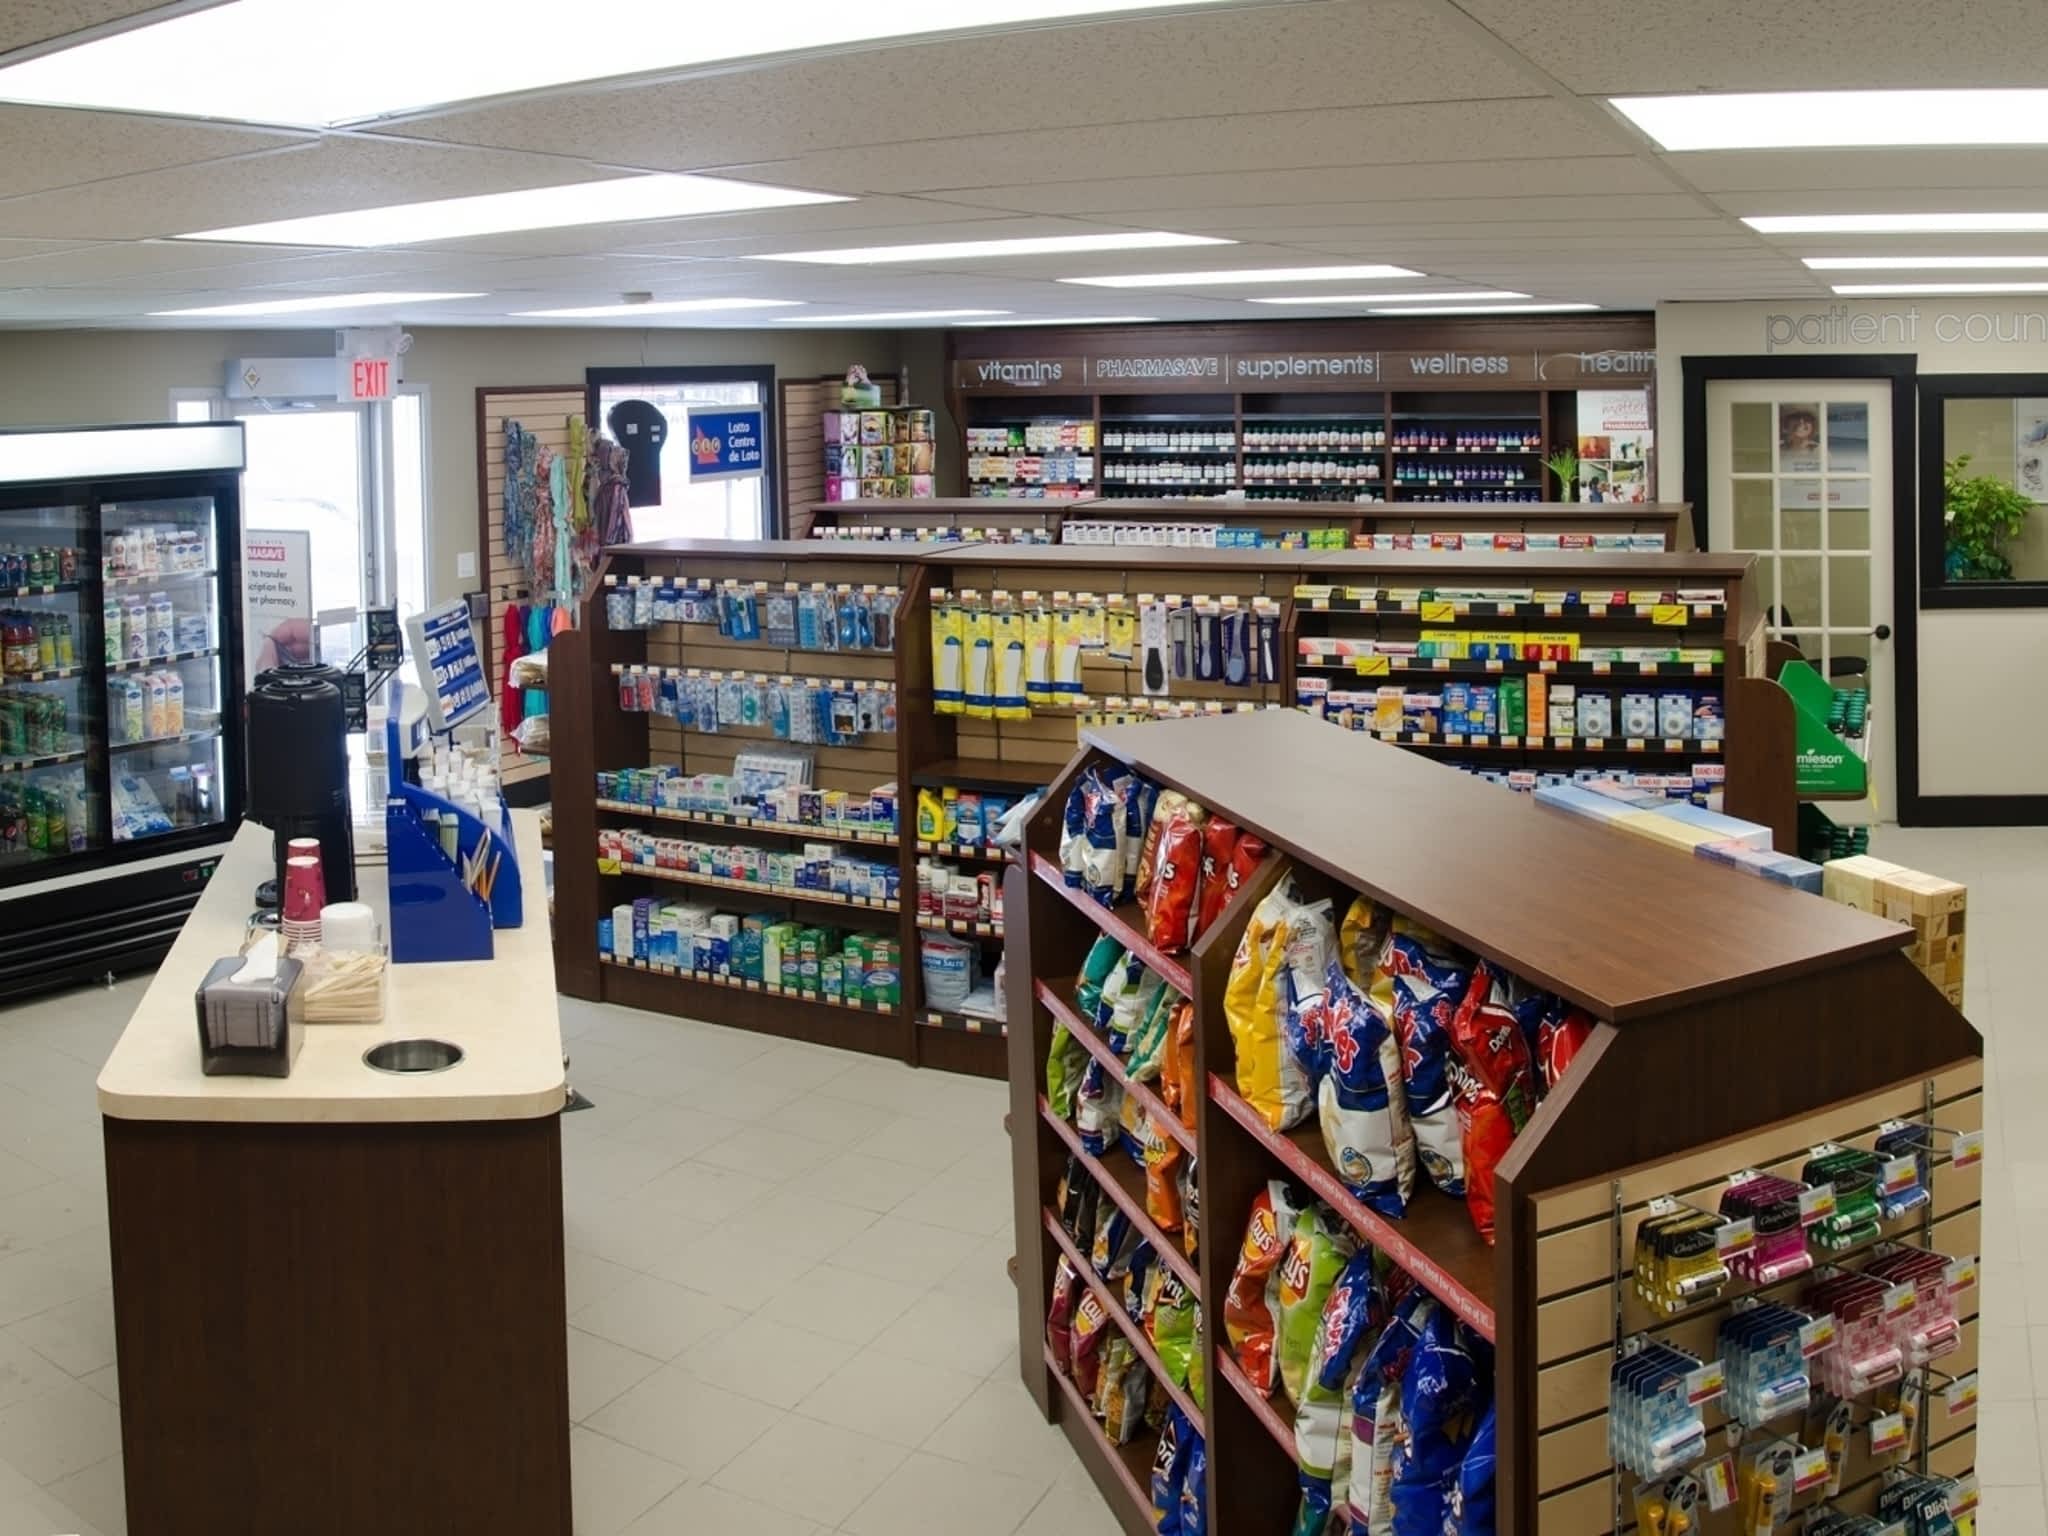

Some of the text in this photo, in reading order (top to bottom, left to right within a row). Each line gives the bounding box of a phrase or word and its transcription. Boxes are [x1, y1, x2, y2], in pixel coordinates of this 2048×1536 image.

[1766, 304, 1919, 353] patient
[978, 360, 1062, 381] vitamins
[1096, 357, 1218, 377] PHARMASAVE
[1236, 353, 1374, 380] supplements
[1410, 353, 1508, 374] wellness
[354, 362, 388, 397] EXIT
[728, 422, 750, 434] Lotto
[728, 435, 756, 449] Centre
[728, 450, 740, 463] de
[260, 568, 288, 578] transfer
